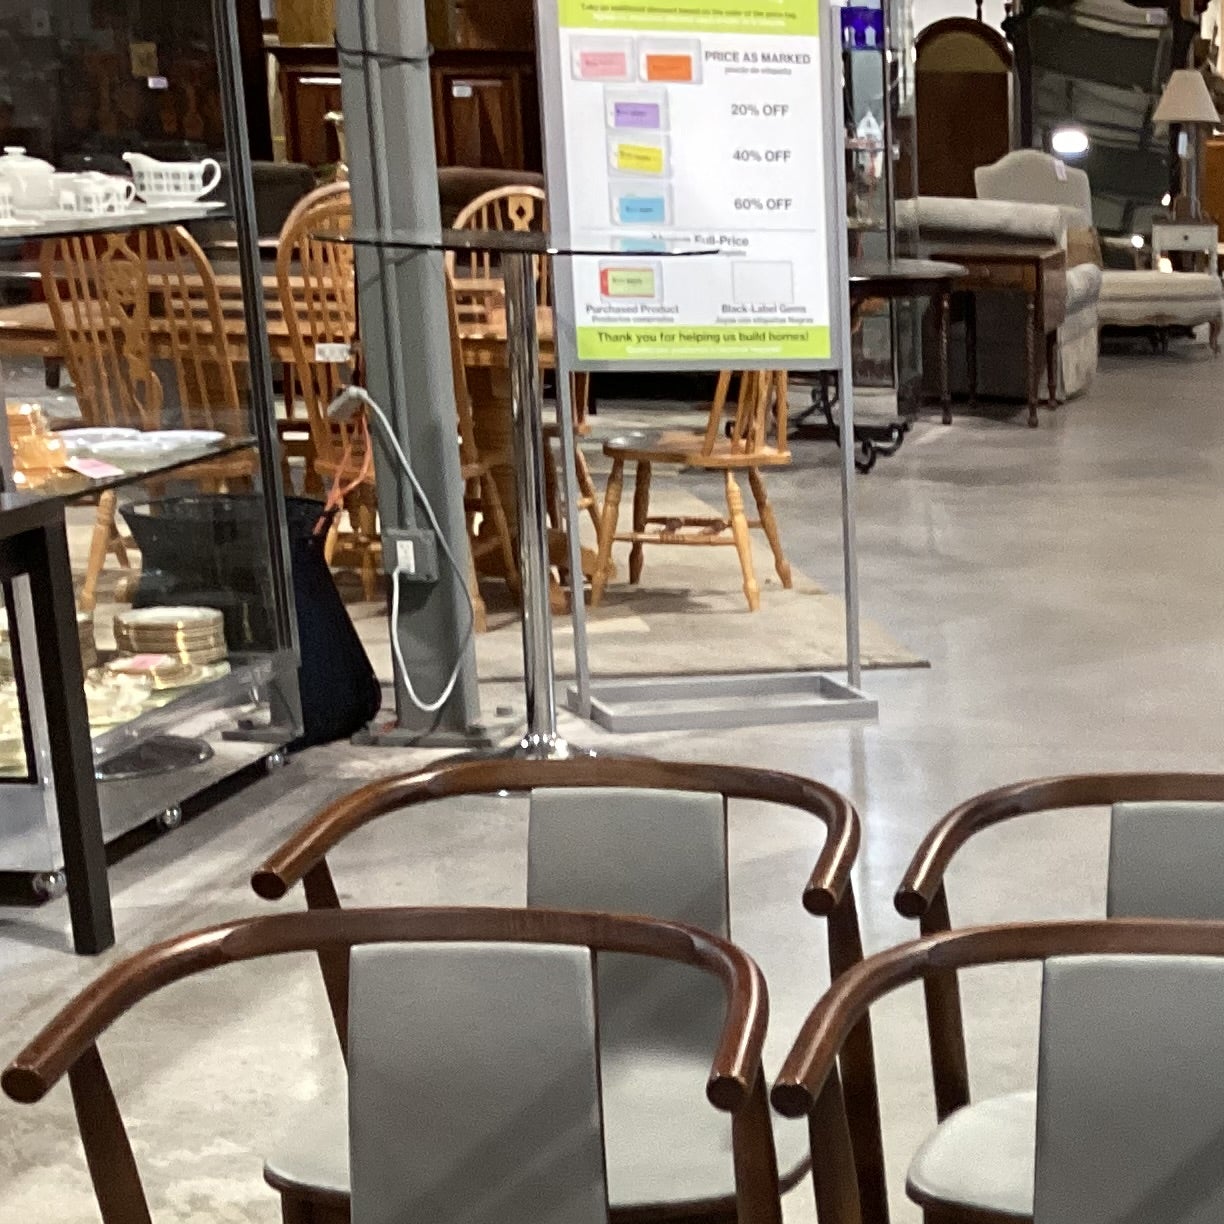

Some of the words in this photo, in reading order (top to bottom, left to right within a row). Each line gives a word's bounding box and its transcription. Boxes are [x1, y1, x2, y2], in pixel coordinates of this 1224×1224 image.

[705, 50, 739, 62] PRICE
[743, 51, 758, 62] AS
[761, 51, 811, 64] MARKED
[731, 103, 760, 116] 20%
[762, 104, 789, 117] OFF
[732, 150, 762, 162] 40%
[764, 150, 791, 163] OFF
[734, 198, 763, 210] 60%
[766, 198, 792, 210] OFF
[585, 304, 638, 314] Purchased
[640, 304, 679, 314] Product
[598, 331, 632, 342] Thank
[635, 333, 657, 343] you
[660, 332, 676, 342] for
[678, 332, 720, 344] helping
[722, 333, 737, 341] us
[738, 331, 766, 342] build
[768, 331, 809, 342] homes!
